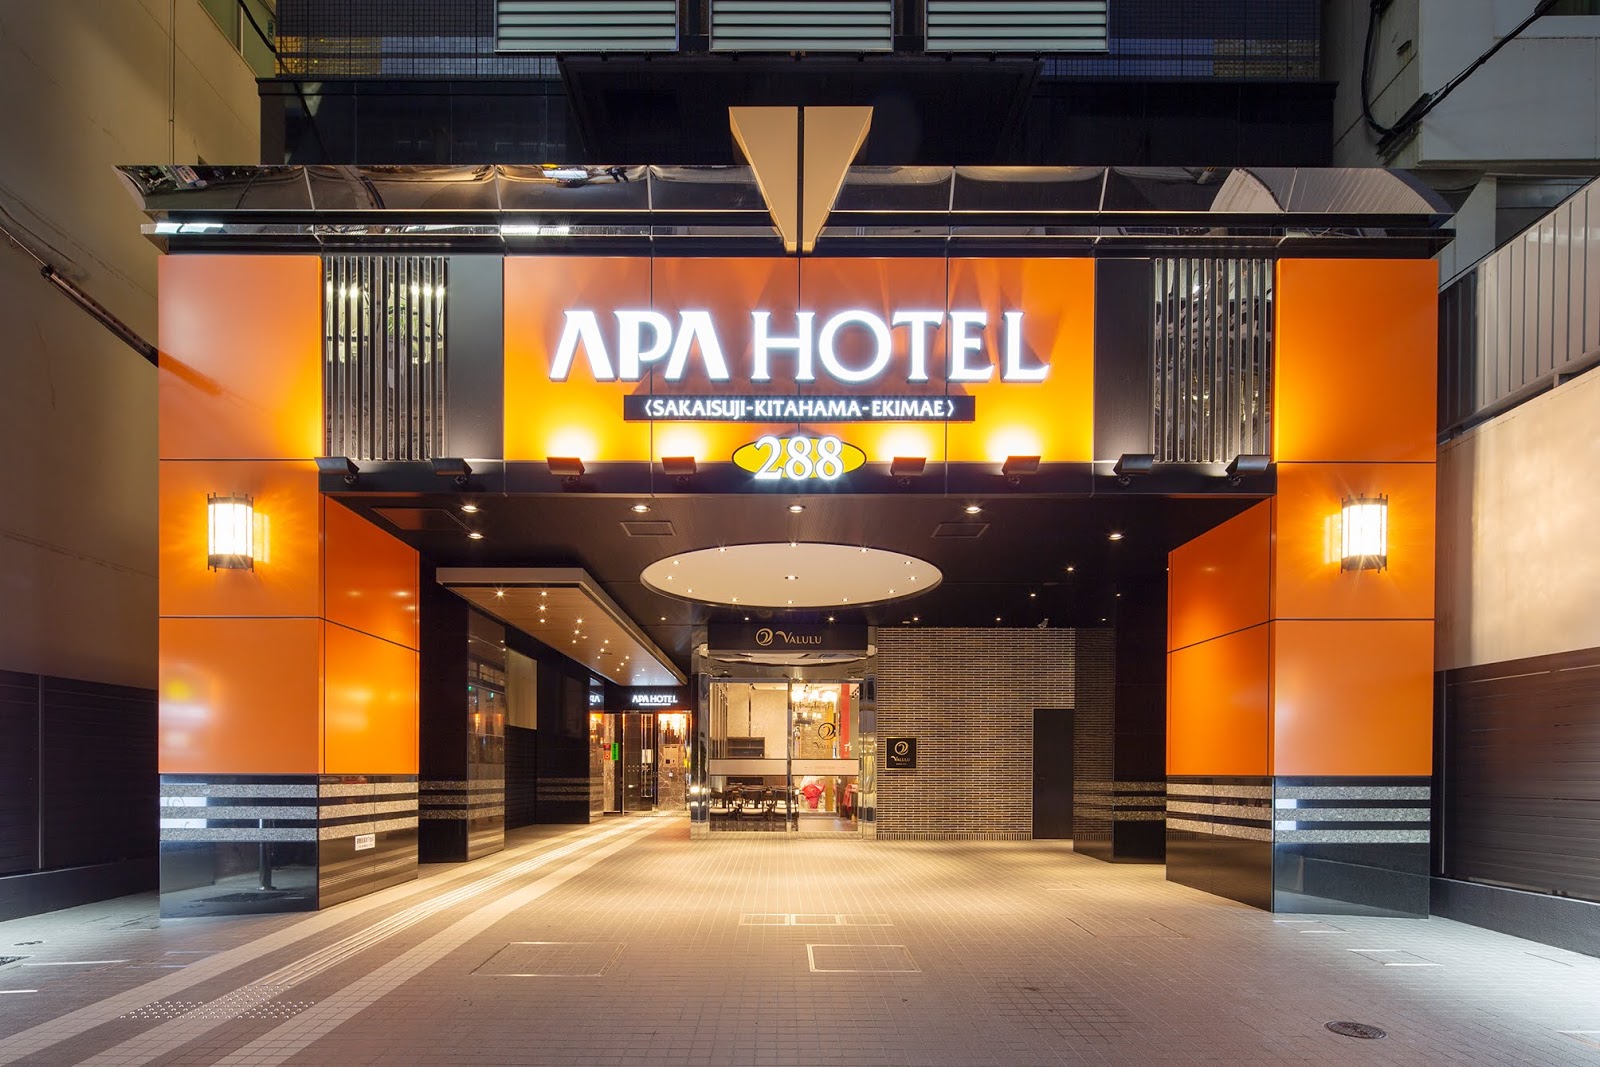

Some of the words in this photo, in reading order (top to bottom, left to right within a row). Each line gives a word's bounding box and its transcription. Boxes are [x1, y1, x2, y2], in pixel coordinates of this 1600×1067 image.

[549, 310, 730, 382] APA
[750, 310, 1050, 384] HOTEL
[754, 435, 845, 481] 288
[632, 694, 649, 703] APA
[649, 694, 678, 703] HOTEL
